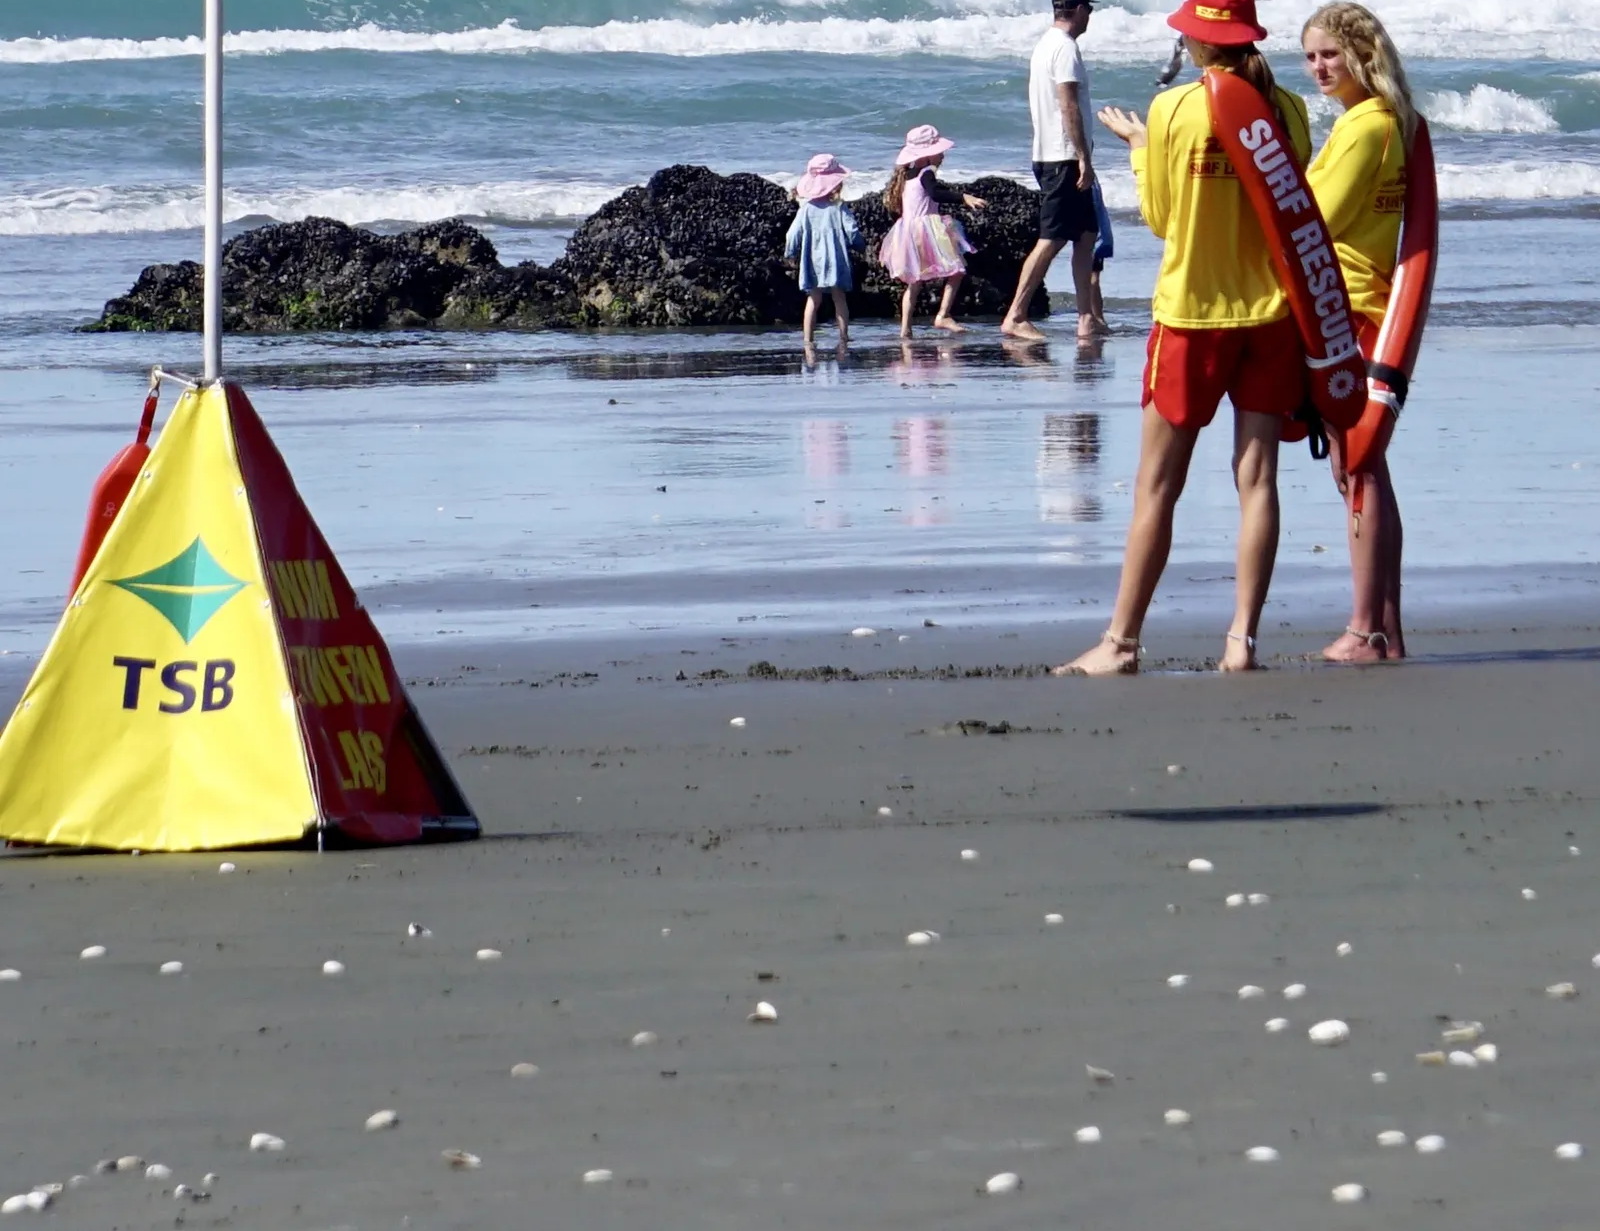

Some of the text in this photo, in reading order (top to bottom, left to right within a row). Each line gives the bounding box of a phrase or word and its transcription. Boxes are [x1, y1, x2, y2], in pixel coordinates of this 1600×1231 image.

[1239, 119, 1355, 358] SURF RESCUE
[113, 656, 237, 715] TSB
